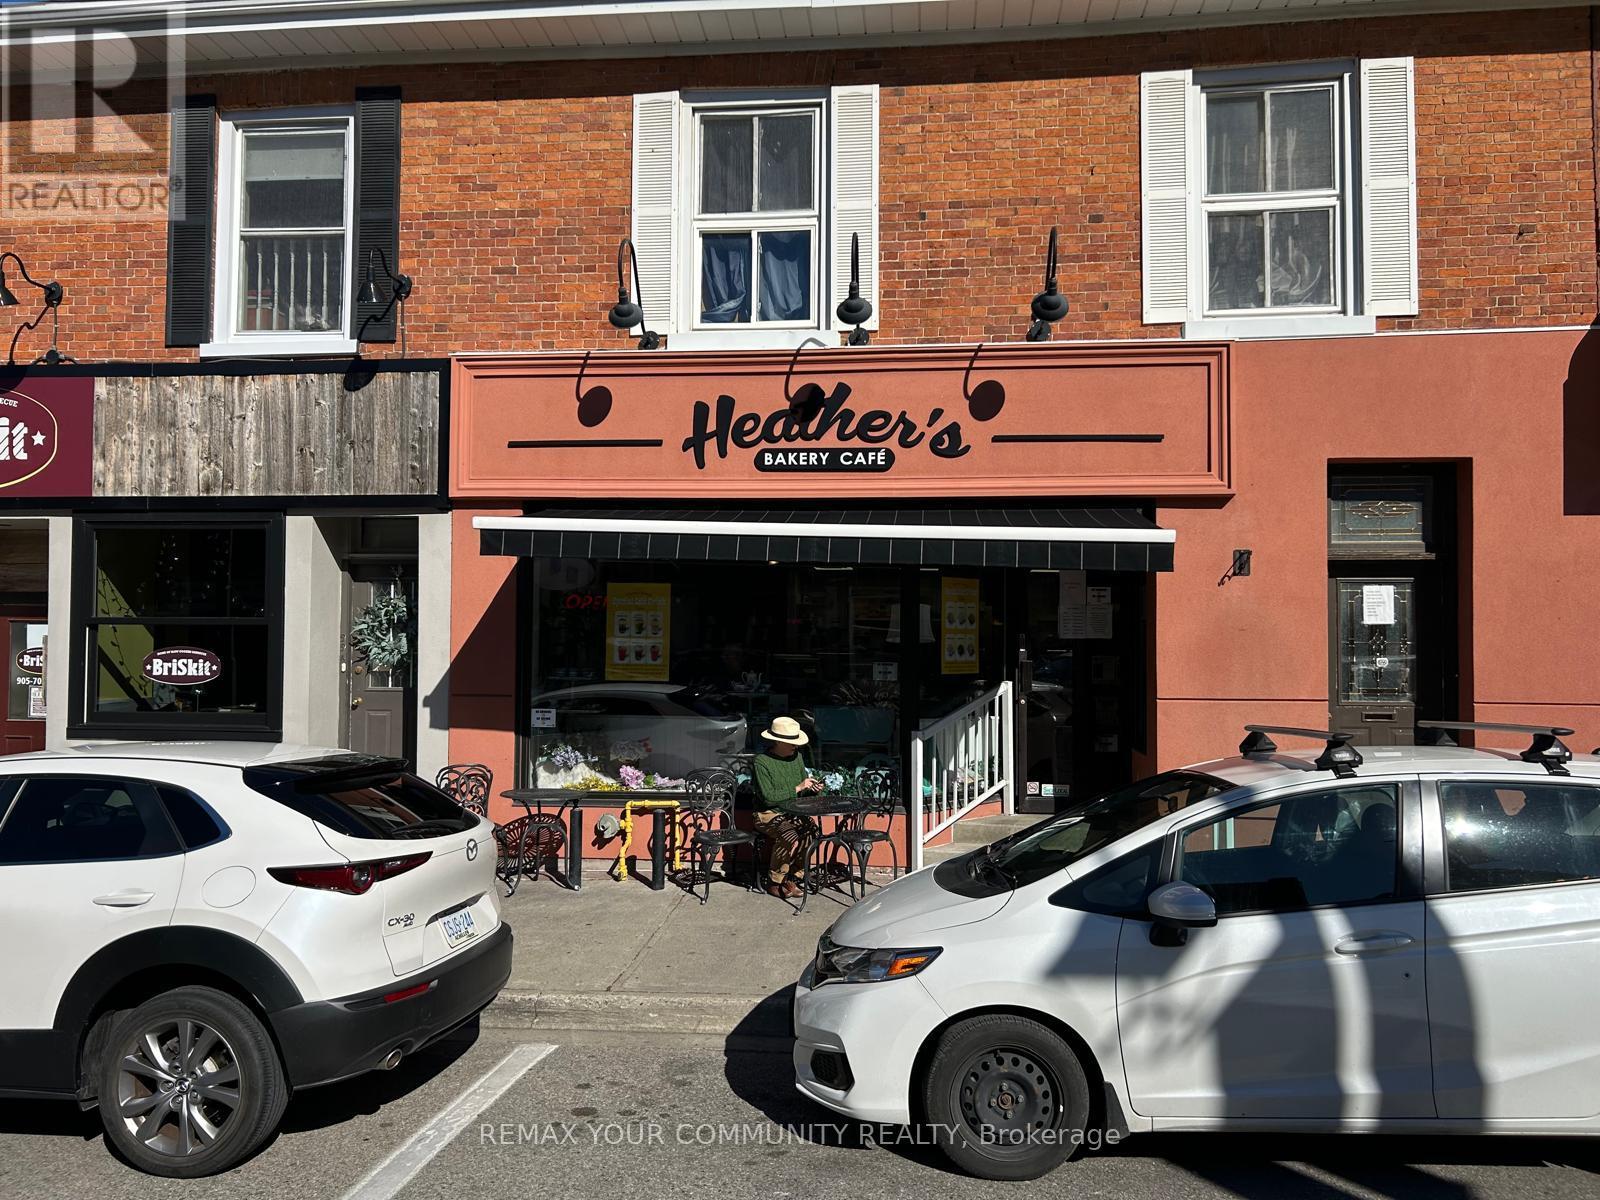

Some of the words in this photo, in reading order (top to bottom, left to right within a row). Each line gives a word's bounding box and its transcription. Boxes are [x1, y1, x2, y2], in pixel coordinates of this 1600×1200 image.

[682, 382, 971, 470] Heather's
[763, 451, 830, 466] BAKERY
[839, 448, 887, 466] CAFÉ
[152, 658, 211, 676] BriSkit
[387, 913, 415, 927] CX-30
